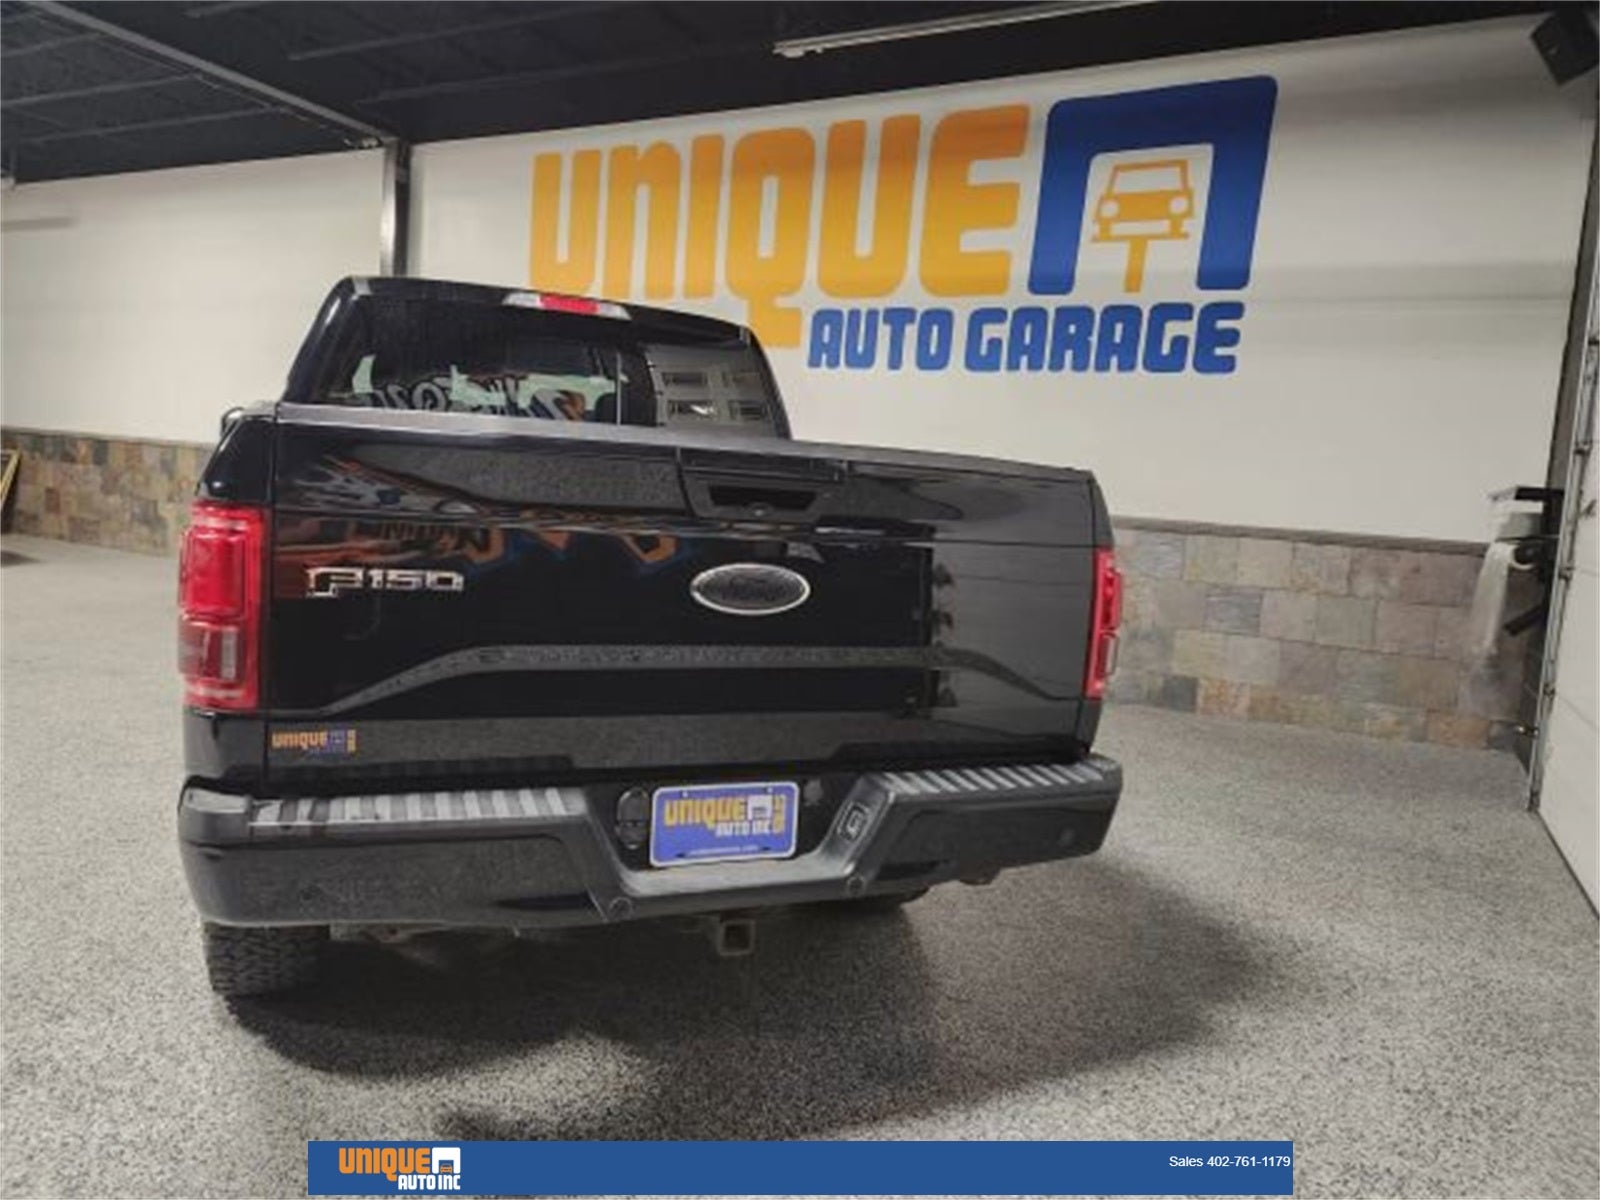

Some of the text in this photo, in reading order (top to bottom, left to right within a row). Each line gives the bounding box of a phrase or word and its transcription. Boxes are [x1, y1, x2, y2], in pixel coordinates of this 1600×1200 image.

[529, 104, 1031, 347] UNIQUE
[809, 302, 1244, 374] AUTO GARAGE
[663, 796, 745, 831] UNIQUE
